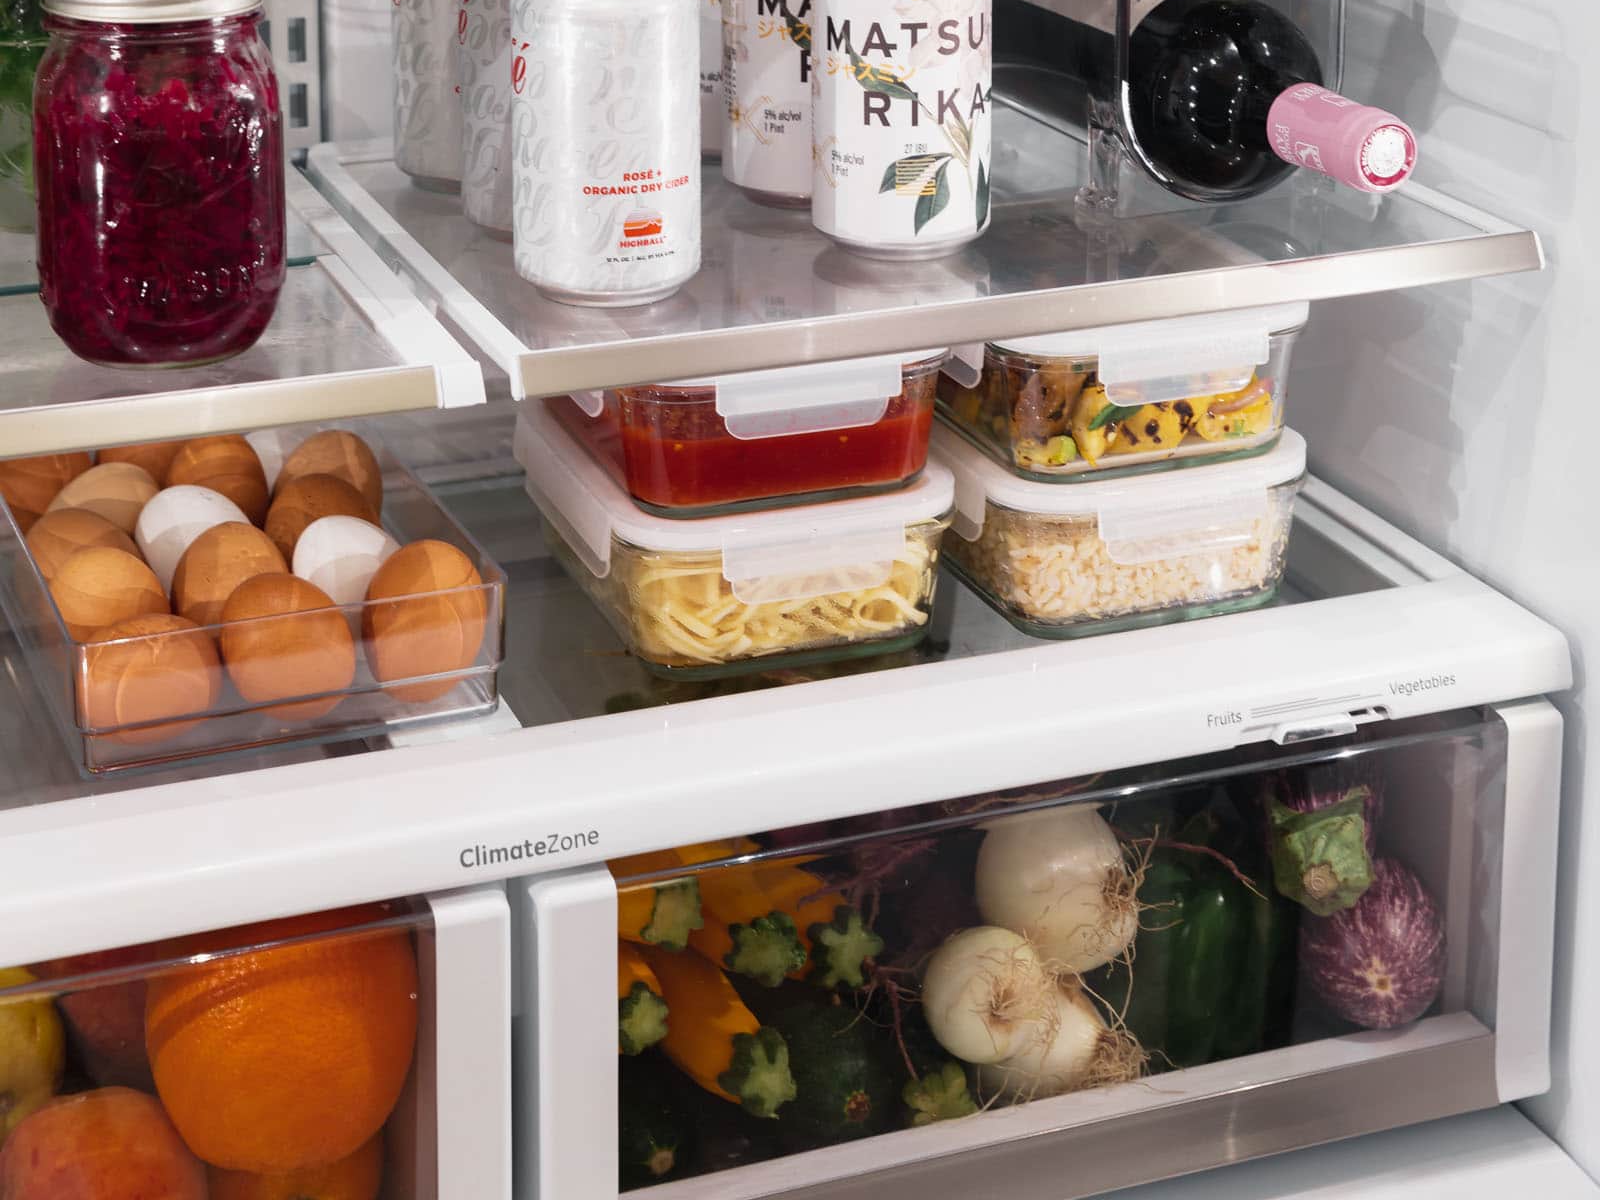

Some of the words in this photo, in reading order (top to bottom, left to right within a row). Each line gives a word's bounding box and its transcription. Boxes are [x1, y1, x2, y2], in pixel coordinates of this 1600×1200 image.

[826, 12, 985, 58] MATSU
[863, 82, 986, 127] RIKA
[583, 185, 638, 196] ORGANIC
[641, 182, 663, 194] DRY
[665, 175, 689, 190] CIDER
[623, 168, 653, 182] ROSÉ
[1388, 673, 1457, 697] Vegetables
[1206, 709, 1243, 728] Fruits
[459, 829, 600, 869] ClimateZone
